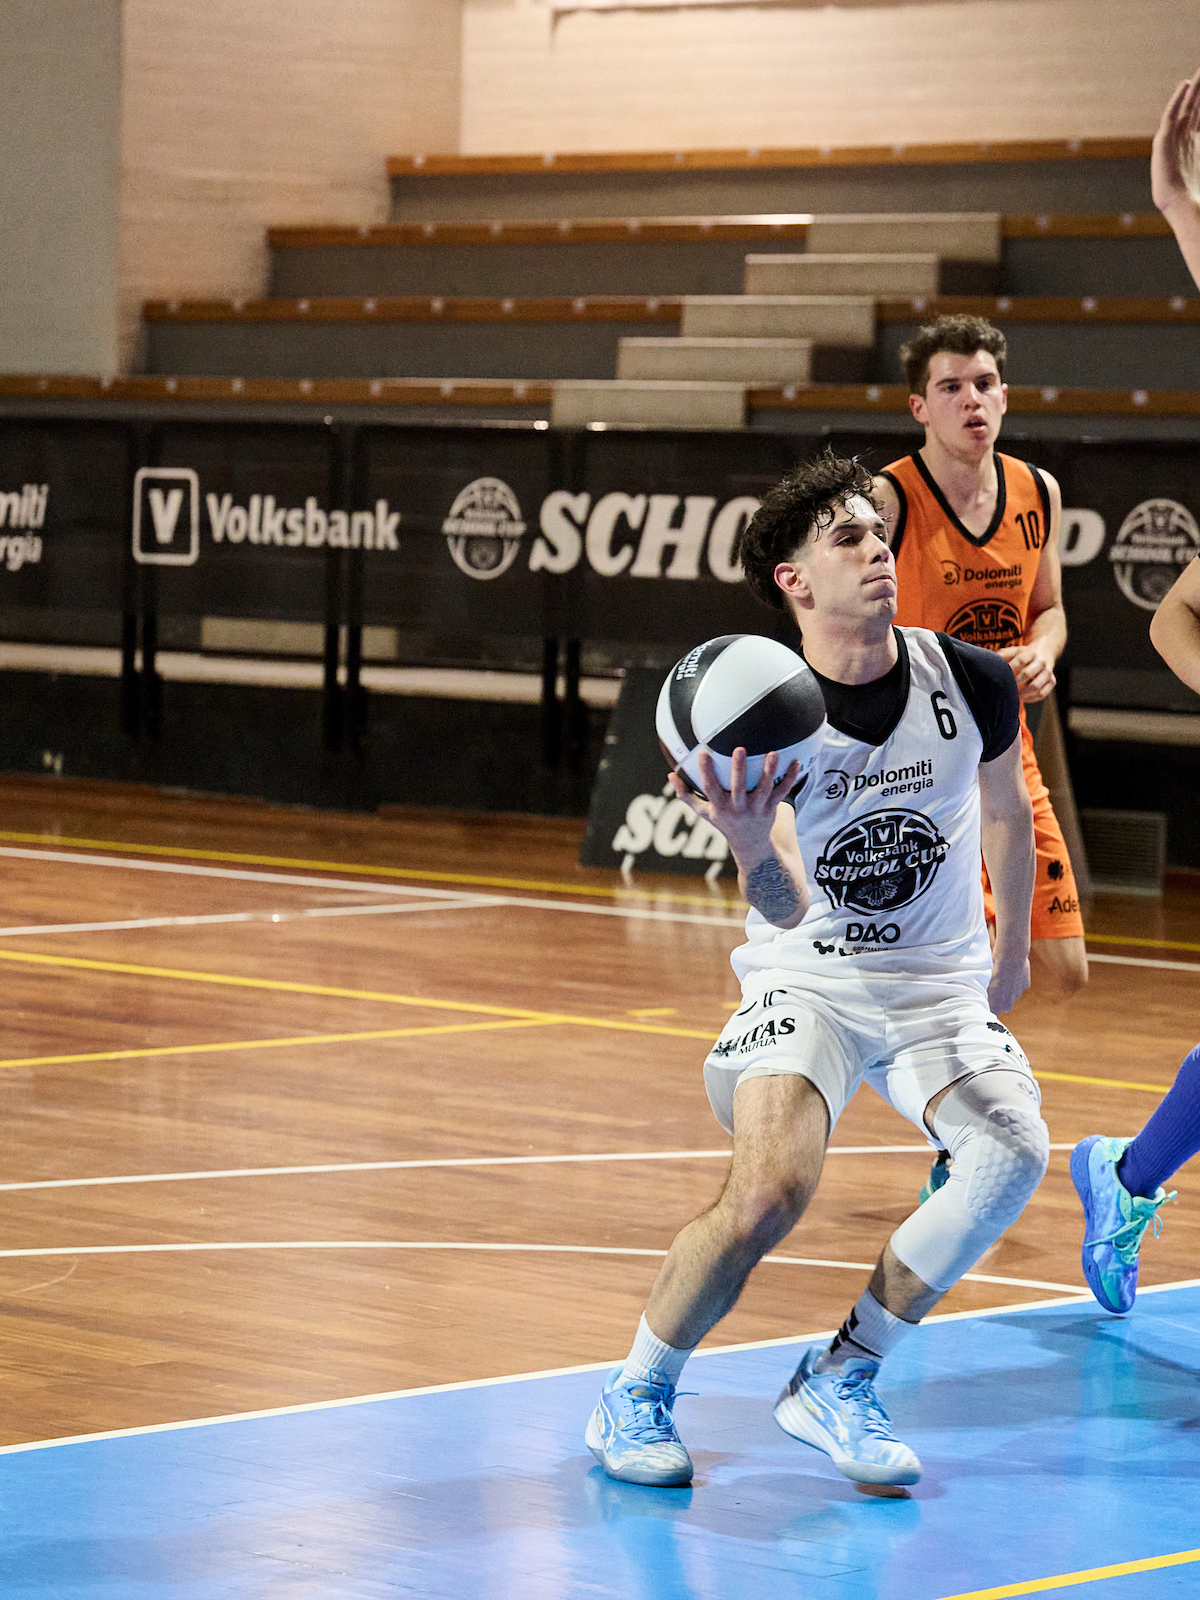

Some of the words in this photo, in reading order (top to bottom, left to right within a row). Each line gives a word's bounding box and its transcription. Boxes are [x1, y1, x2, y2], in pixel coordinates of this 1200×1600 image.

[206, 492, 400, 550] Volksbank
[1015, 510, 1040, 551] 10
[964, 564, 1022, 583] Dolomiti
[985, 579, 1022, 590] energia
[930, 690, 957, 740] 6
[854, 759, 932, 792] Dolomiti
[880, 778, 934, 797] energia
[815, 858, 901, 882] SCHOOL
[845, 922, 901, 944] DAO
[741, 1017, 796, 1047] ITAS
[737, 1037, 777, 1056] MUTUA
